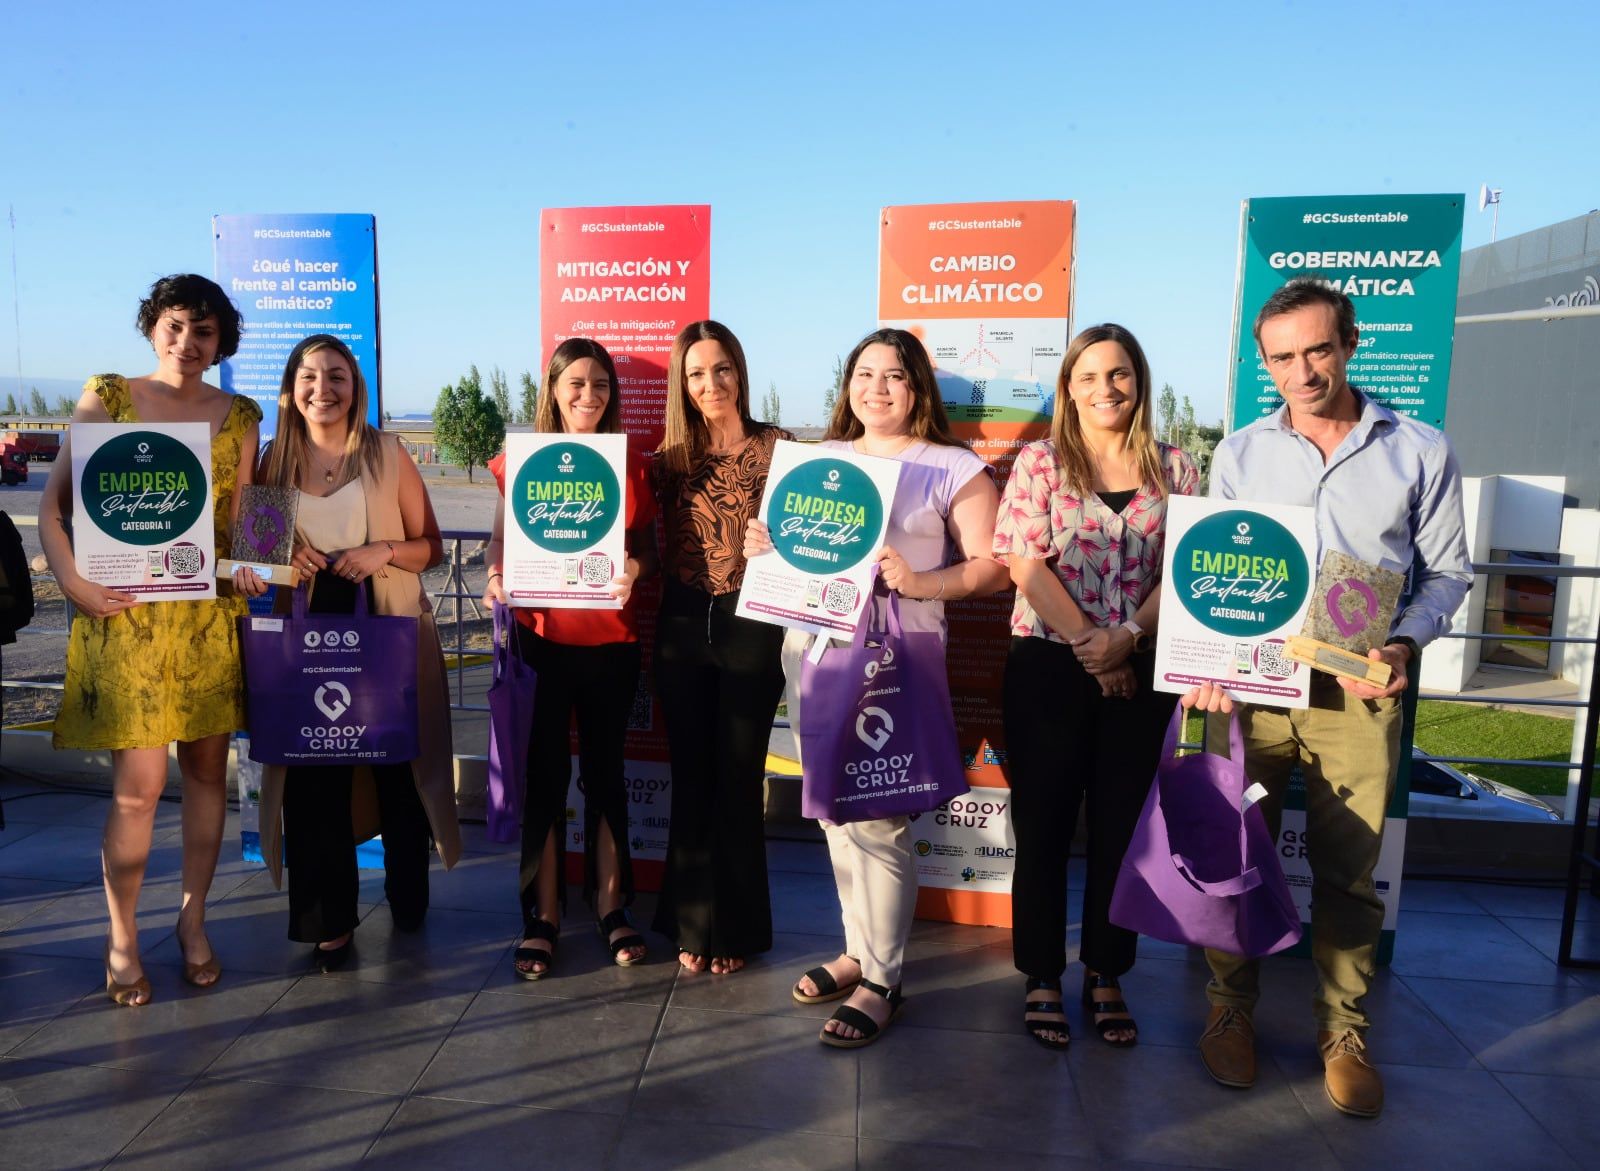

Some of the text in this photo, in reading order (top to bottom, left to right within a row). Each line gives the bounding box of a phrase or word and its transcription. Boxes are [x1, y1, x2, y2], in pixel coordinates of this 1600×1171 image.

[929, 218, 1022, 231] #GCSustentable
[1303, 212, 1408, 224] #GCSustentable
[254, 229, 332, 239] #GCSustentable
[582, 222, 664, 233] #GCSustentable
[252, 258, 338, 273] ¿Qué hacer
[557, 257, 690, 278] MITIGACIÓN Y
[930, 254, 1016, 273] CAMBIO
[1269, 250, 1442, 269] GOBERNANZA
[232, 279, 357, 292] frente al cambio
[560, 282, 686, 303] ADAPTACIÓN
[902, 278, 1043, 304] CLIMÁTICO
[1285, 275, 1415, 296] MÁTICA
[256, 296, 333, 310] climático?
[292, 321, 305, 329] vida
[306, 321, 324, 329] tienen
[338, 323, 352, 331] gran
[572, 320, 675, 332] ¿Qué es la mitigación?
[1360, 351, 1399, 361] climático
[1400, 353, 1434, 363] requiere
[1360, 365, 1378, 373] para
[1380, 363, 1418, 371] construir
[1354, 374, 1369, 382] más
[1371, 374, 1415, 382] sostenible.
[1418, 374, 1428, 383] Es
[1378, 386, 1388, 394] de
[1390, 386, 1398, 394] la
[1401, 386, 1419, 394] ONU
[1390, 397, 1425, 405] alianzas
[99, 471, 189, 493] EMPRESA
[527, 481, 605, 502] EMPRESA
[101, 487, 190, 517] Sostenible
[784, 492, 866, 527] EMPRESA
[527, 496, 604, 525] Sostenible
[121, 520, 171, 531] CATEGORIA II
[780, 513, 862, 545] Sostenible
[544, 529, 587, 539] CATEGORIA II
[793, 545, 839, 563] CATEGORIA II
[1191, 549, 1288, 581] EMPRESA
[1190, 571, 1288, 604] Sostenible
[1210, 606, 1265, 622] CATEGORIA II
[300, 725, 367, 738] GODOY
[309, 738, 359, 750] CRUZ
[845, 752, 914, 775] GODOY
[856, 769, 910, 789] CRUZ
[936, 813, 988, 829] CRUZ
